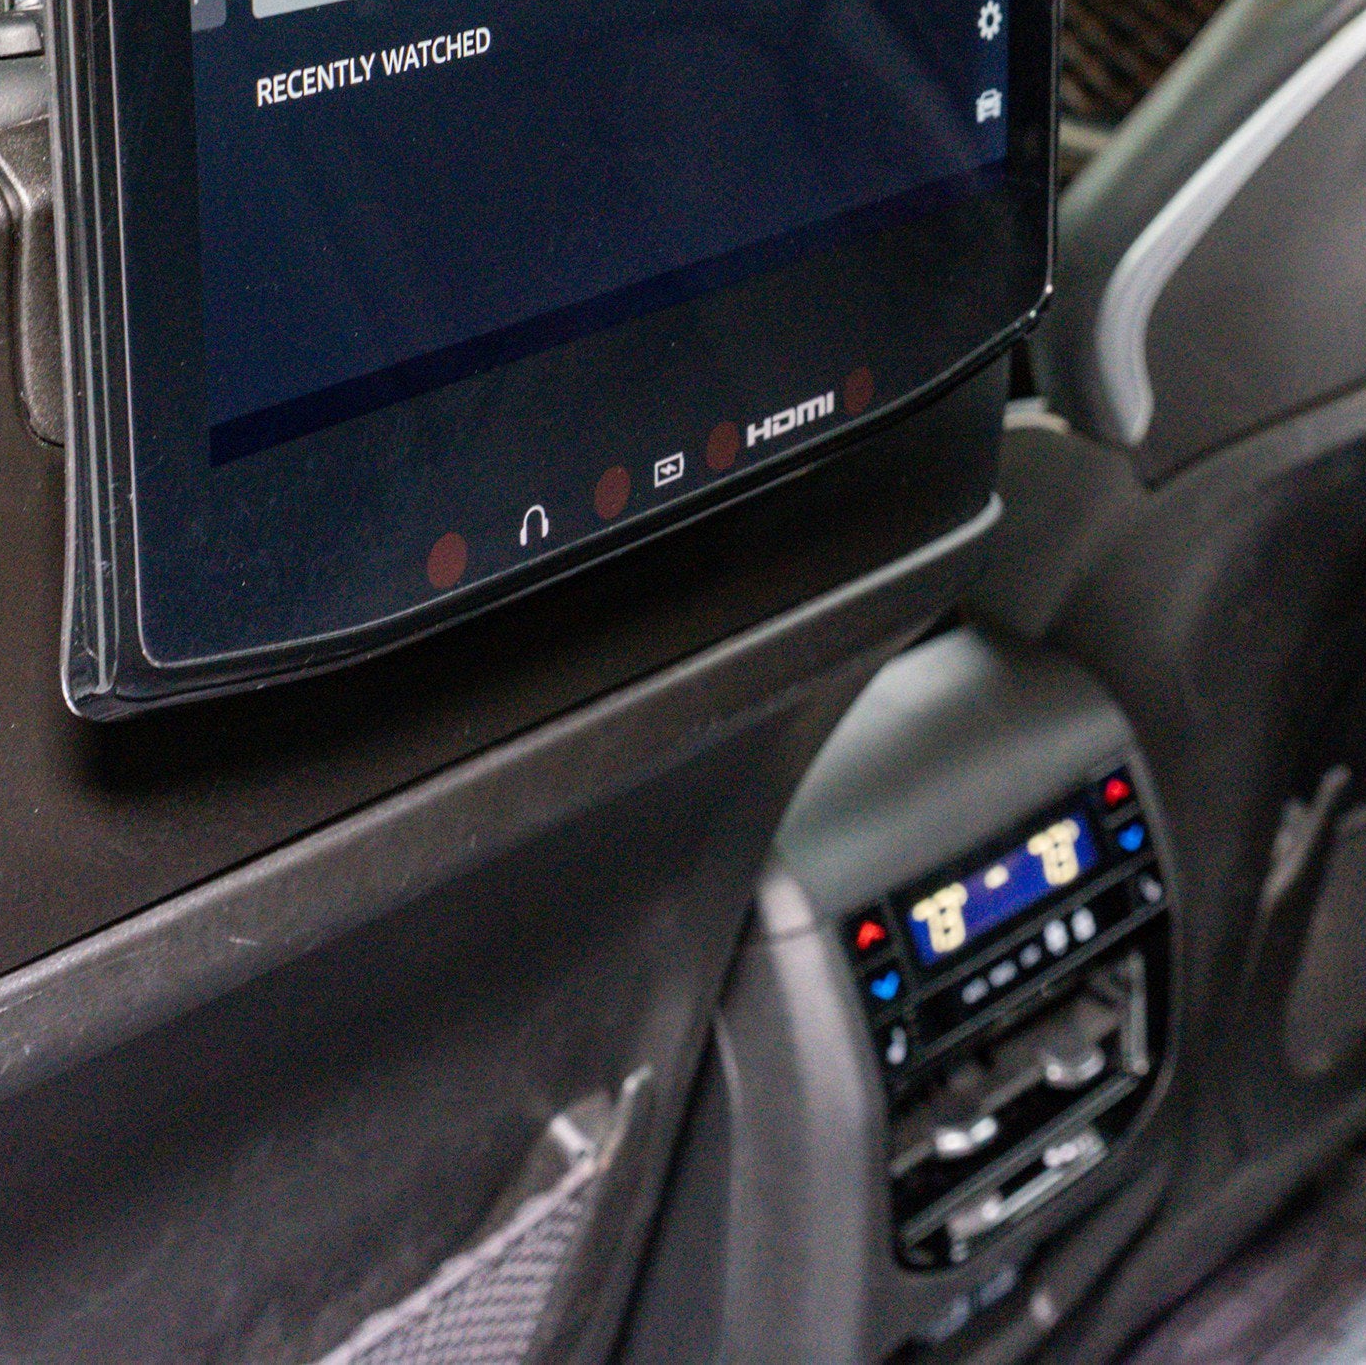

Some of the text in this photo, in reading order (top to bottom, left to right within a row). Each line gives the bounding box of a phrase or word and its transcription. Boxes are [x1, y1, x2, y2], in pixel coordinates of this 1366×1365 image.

[256, 26, 492, 107] RECENTLY WATCHED
[746, 391, 835, 448] HDMI
